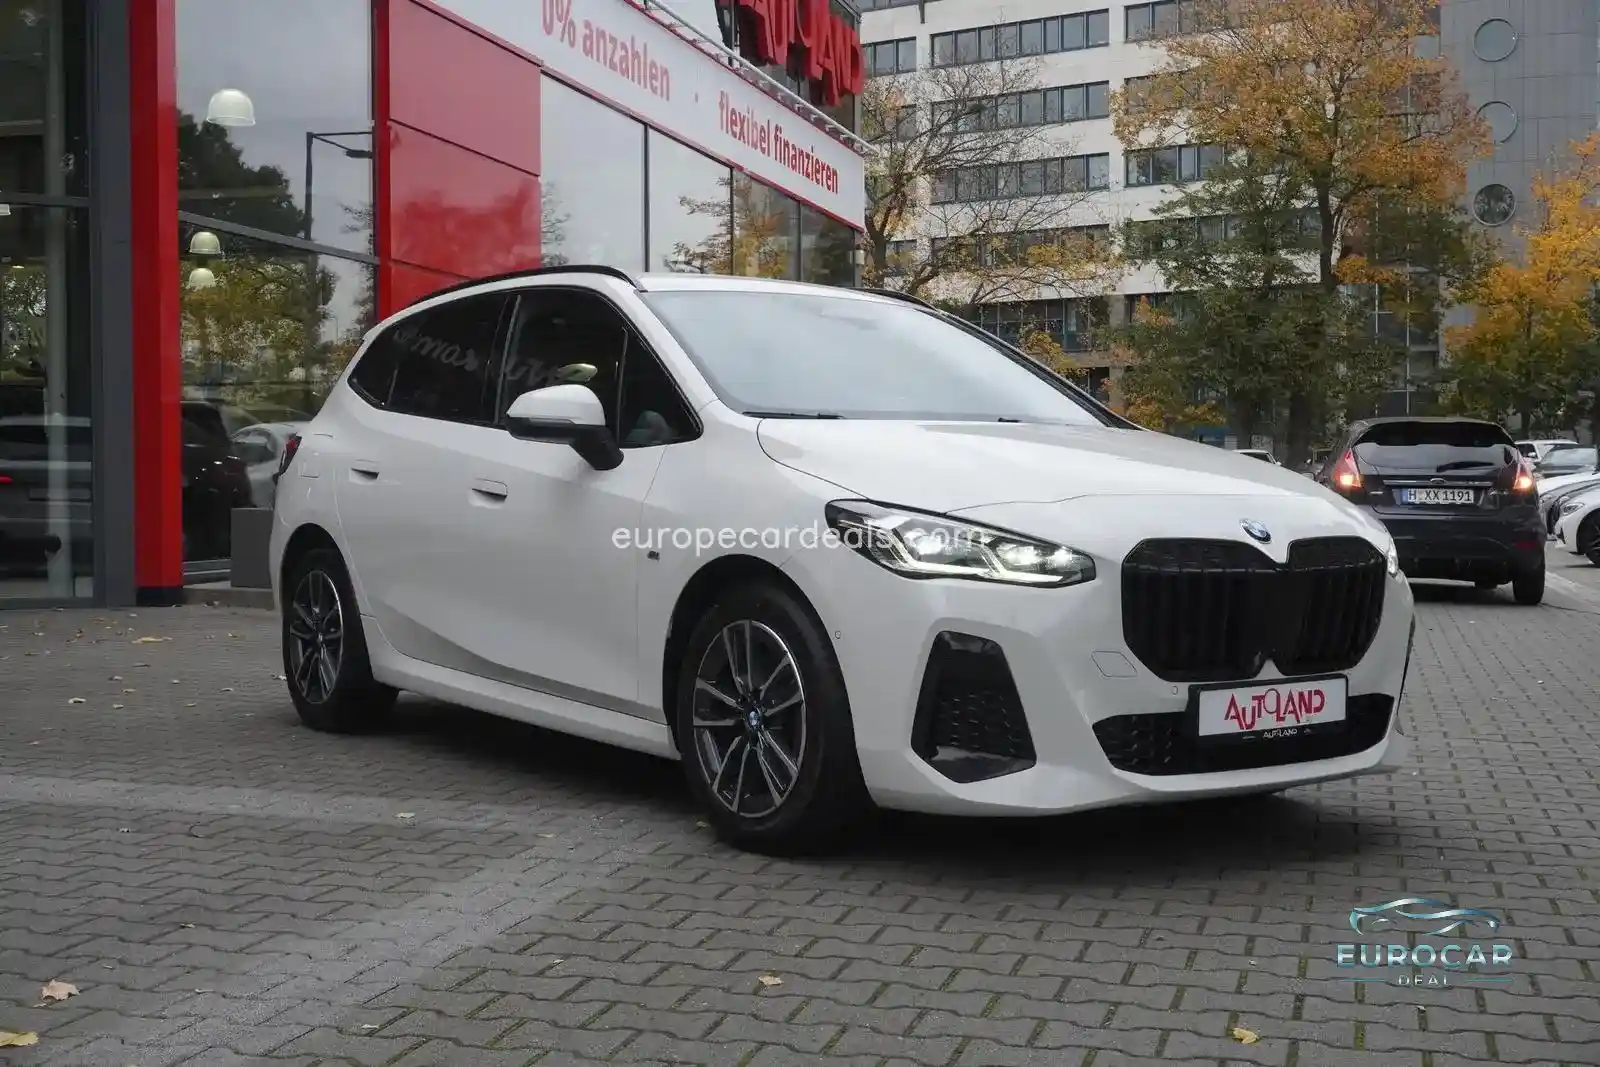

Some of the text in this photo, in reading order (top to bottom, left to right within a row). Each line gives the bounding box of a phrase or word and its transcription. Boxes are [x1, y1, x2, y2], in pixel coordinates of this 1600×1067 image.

[582, 19, 670, 101] anzahlen
[718, 90, 770, 157] flexibel
[774, 123, 838, 193] finanzieren
[1408, 489, 1471, 501] H XX 1191
[1224, 688, 1325, 729] AUTOLAND
